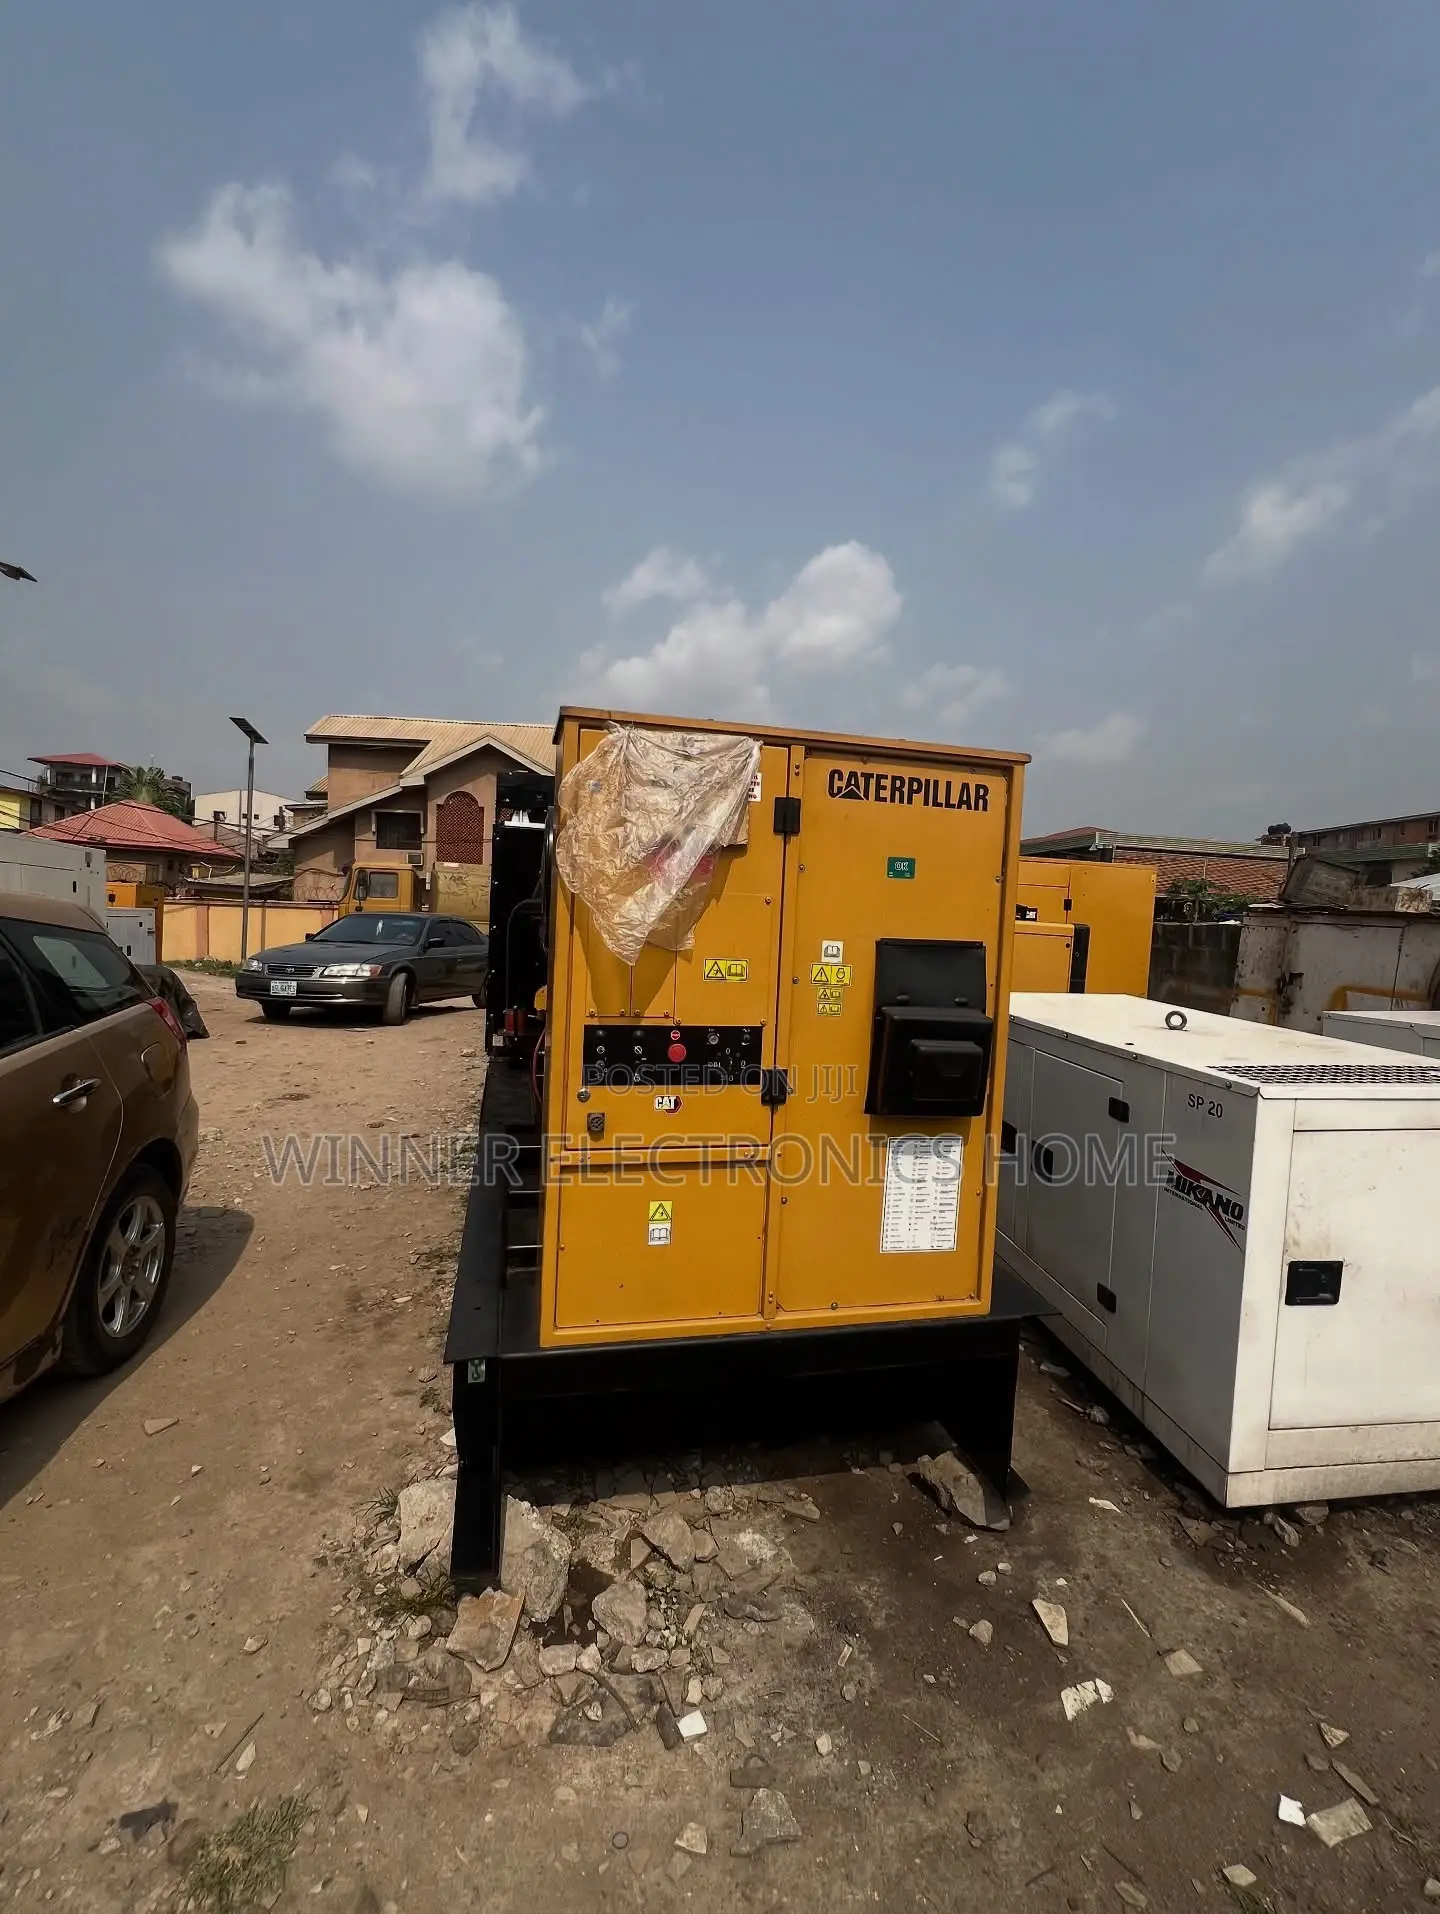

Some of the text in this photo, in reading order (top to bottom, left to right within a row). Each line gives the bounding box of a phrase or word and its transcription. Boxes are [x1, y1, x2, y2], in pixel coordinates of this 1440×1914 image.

[828, 769, 990, 812] CATERPILLAR
[895, 861, 909, 871] OK
[655, 1095, 677, 1110] CAT
[1187, 1093, 1223, 1118] SP 20
